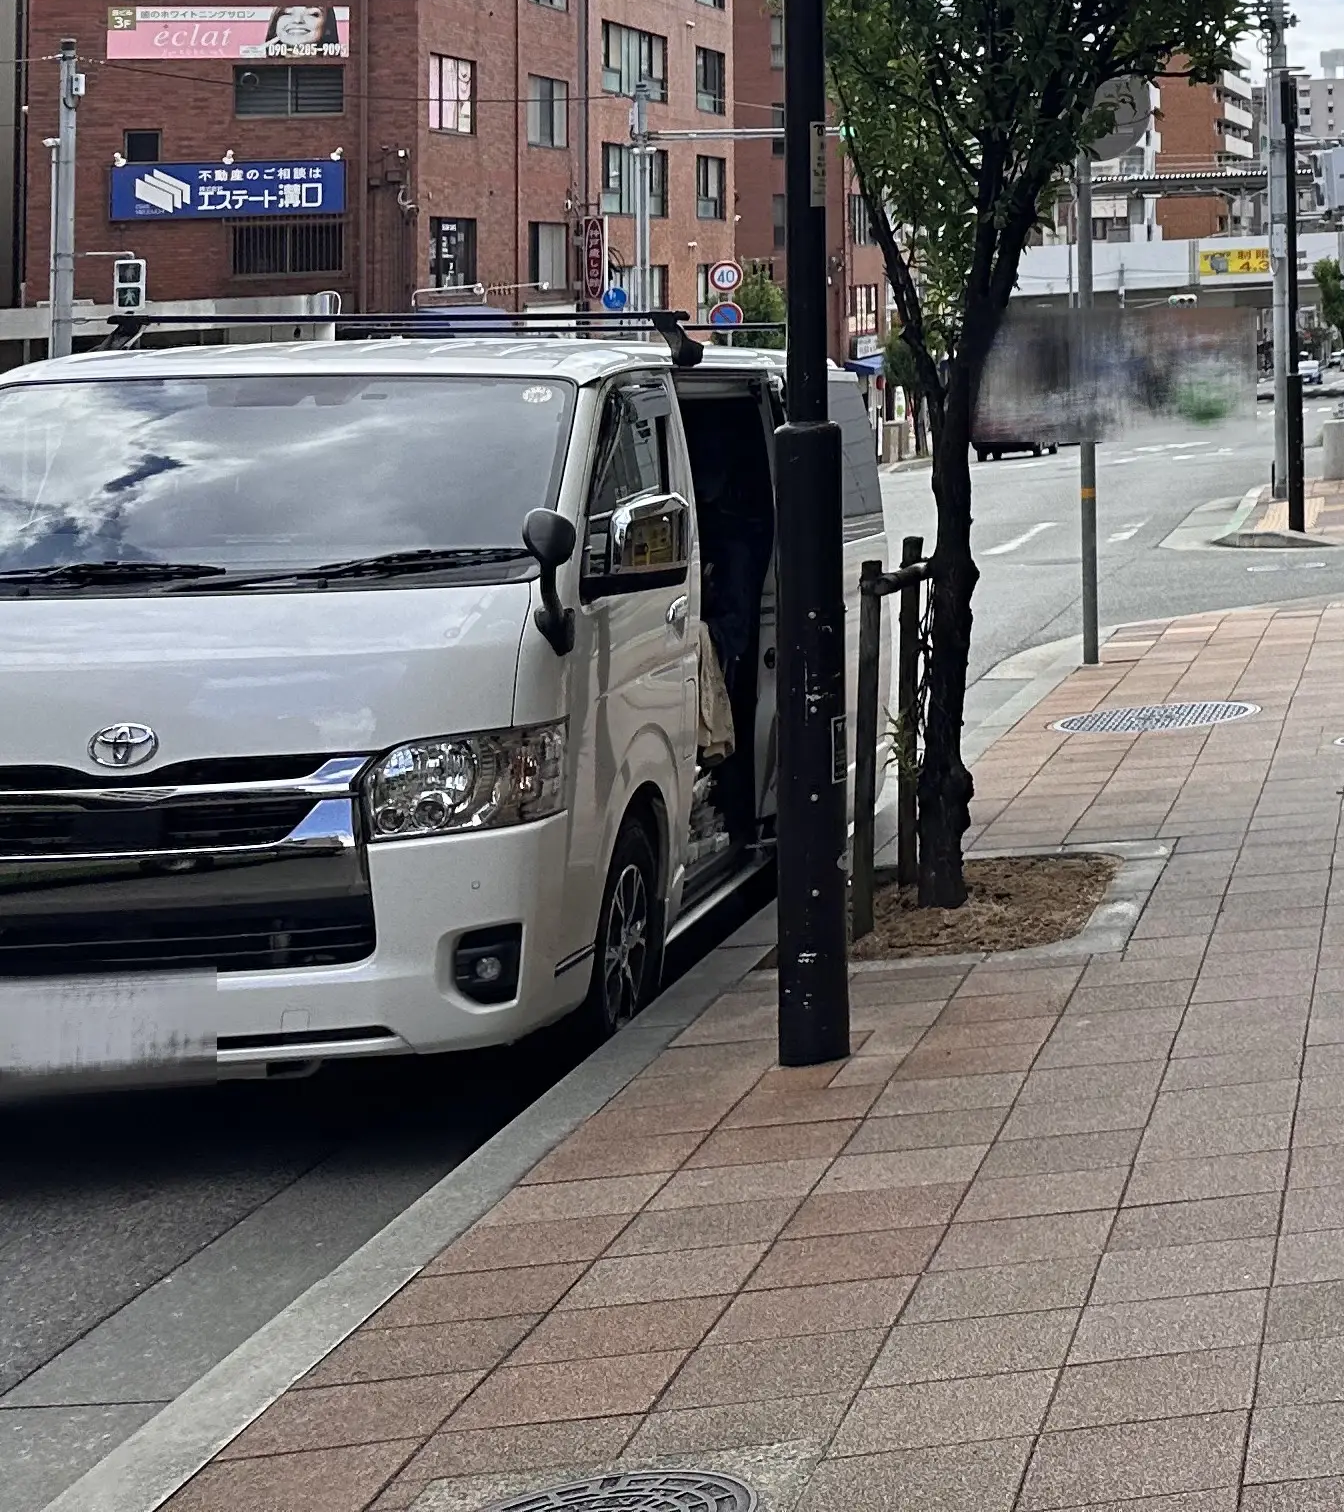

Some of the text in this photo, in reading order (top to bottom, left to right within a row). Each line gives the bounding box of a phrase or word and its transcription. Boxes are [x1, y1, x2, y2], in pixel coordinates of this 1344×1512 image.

[113, 16, 132, 29] 3F
[198, 167, 322, 181] 不動産のご相談は
[198, 183, 322, 211] エステート溝口
[717, 270, 735, 284] 40
